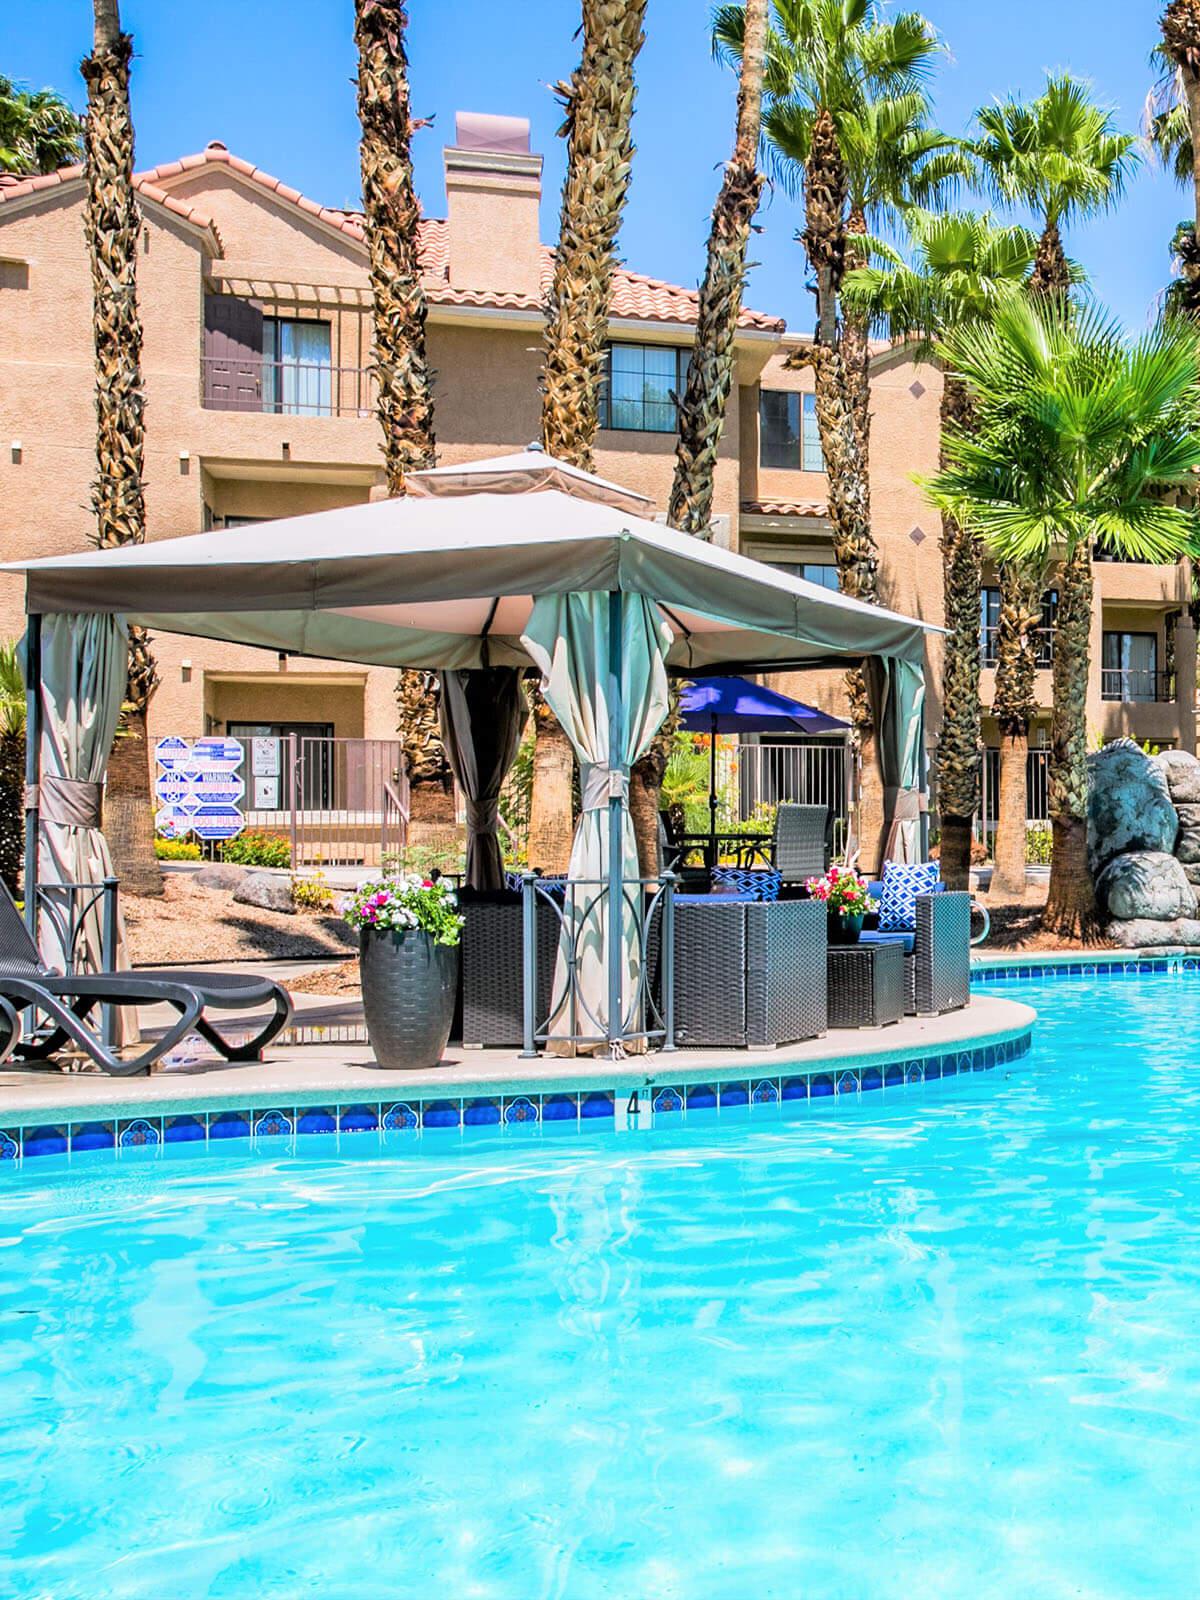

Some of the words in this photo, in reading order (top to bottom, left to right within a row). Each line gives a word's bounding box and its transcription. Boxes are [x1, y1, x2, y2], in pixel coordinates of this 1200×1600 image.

[166, 772, 181, 782] NO
[202, 772, 233, 782] WARNING
[192, 816, 215, 826] POOL
[217, 816, 243, 826] RULES
[627, 1090, 640, 1113] 4
